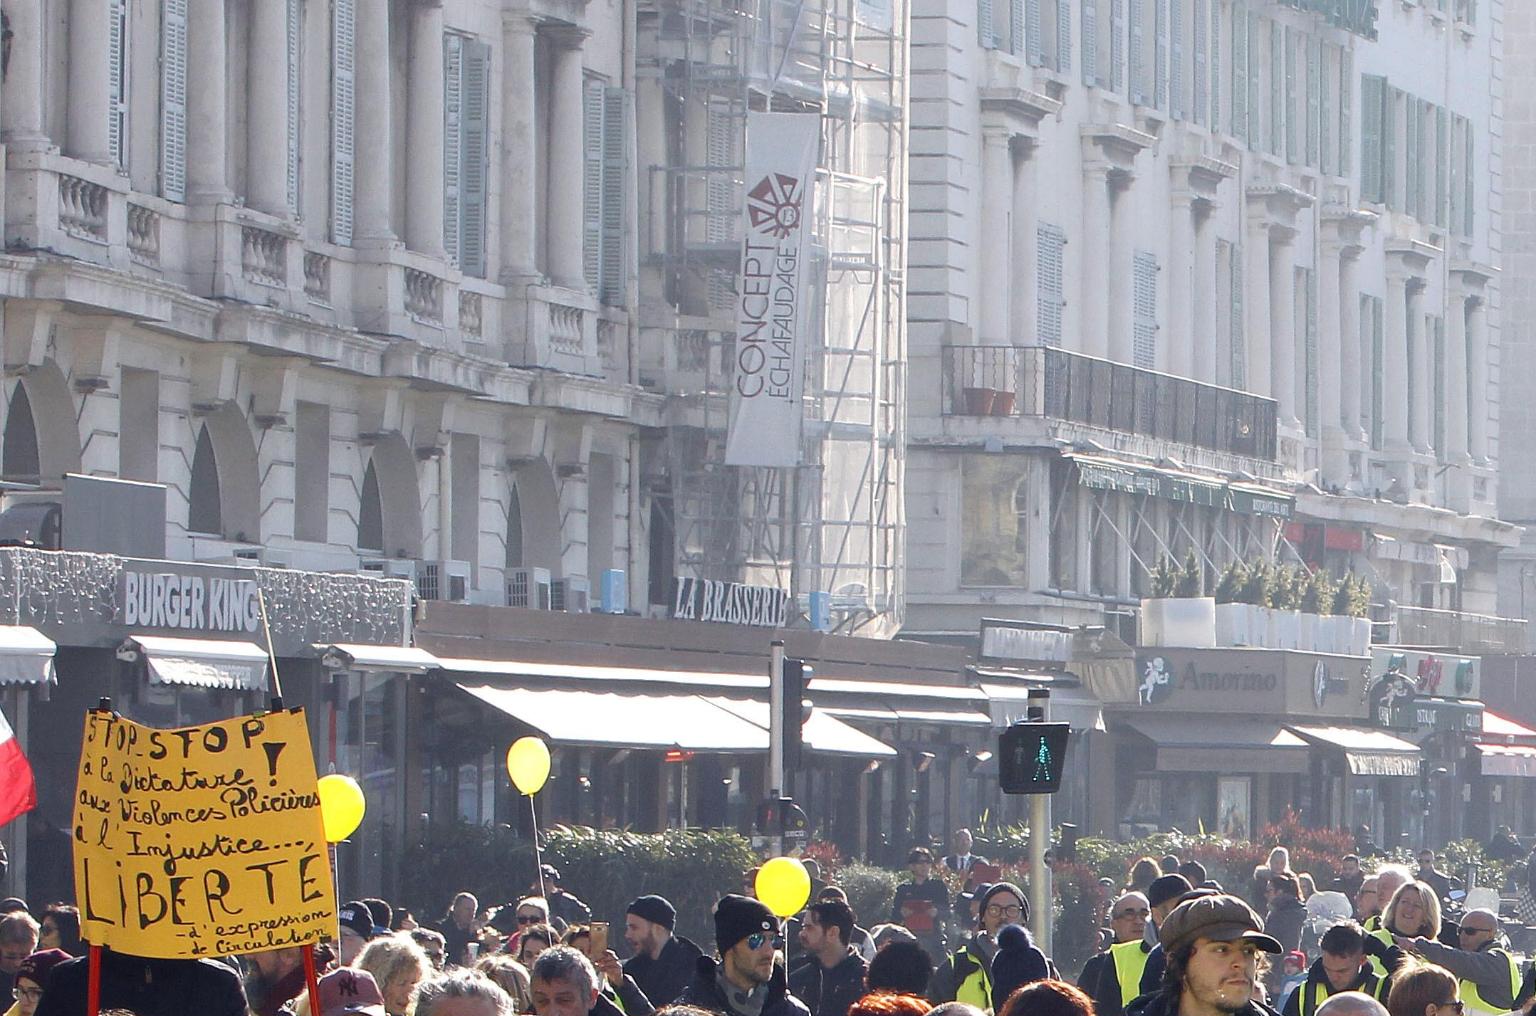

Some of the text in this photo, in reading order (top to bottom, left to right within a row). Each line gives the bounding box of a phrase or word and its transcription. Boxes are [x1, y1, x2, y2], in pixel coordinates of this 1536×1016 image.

[737, 238, 776, 398] CONCEPT
[125, 571, 259, 632] BURGER KING
[674, 576, 788, 627] LA BRASSERIE
[1178, 660, 1277, 692] Amorino
[83, 753, 93, 776] à
[100, 756, 115, 784] la
[80, 786, 321, 826] aux Violences Policières
[75, 809, 88, 843] à
[216, 911, 332, 938] expression
